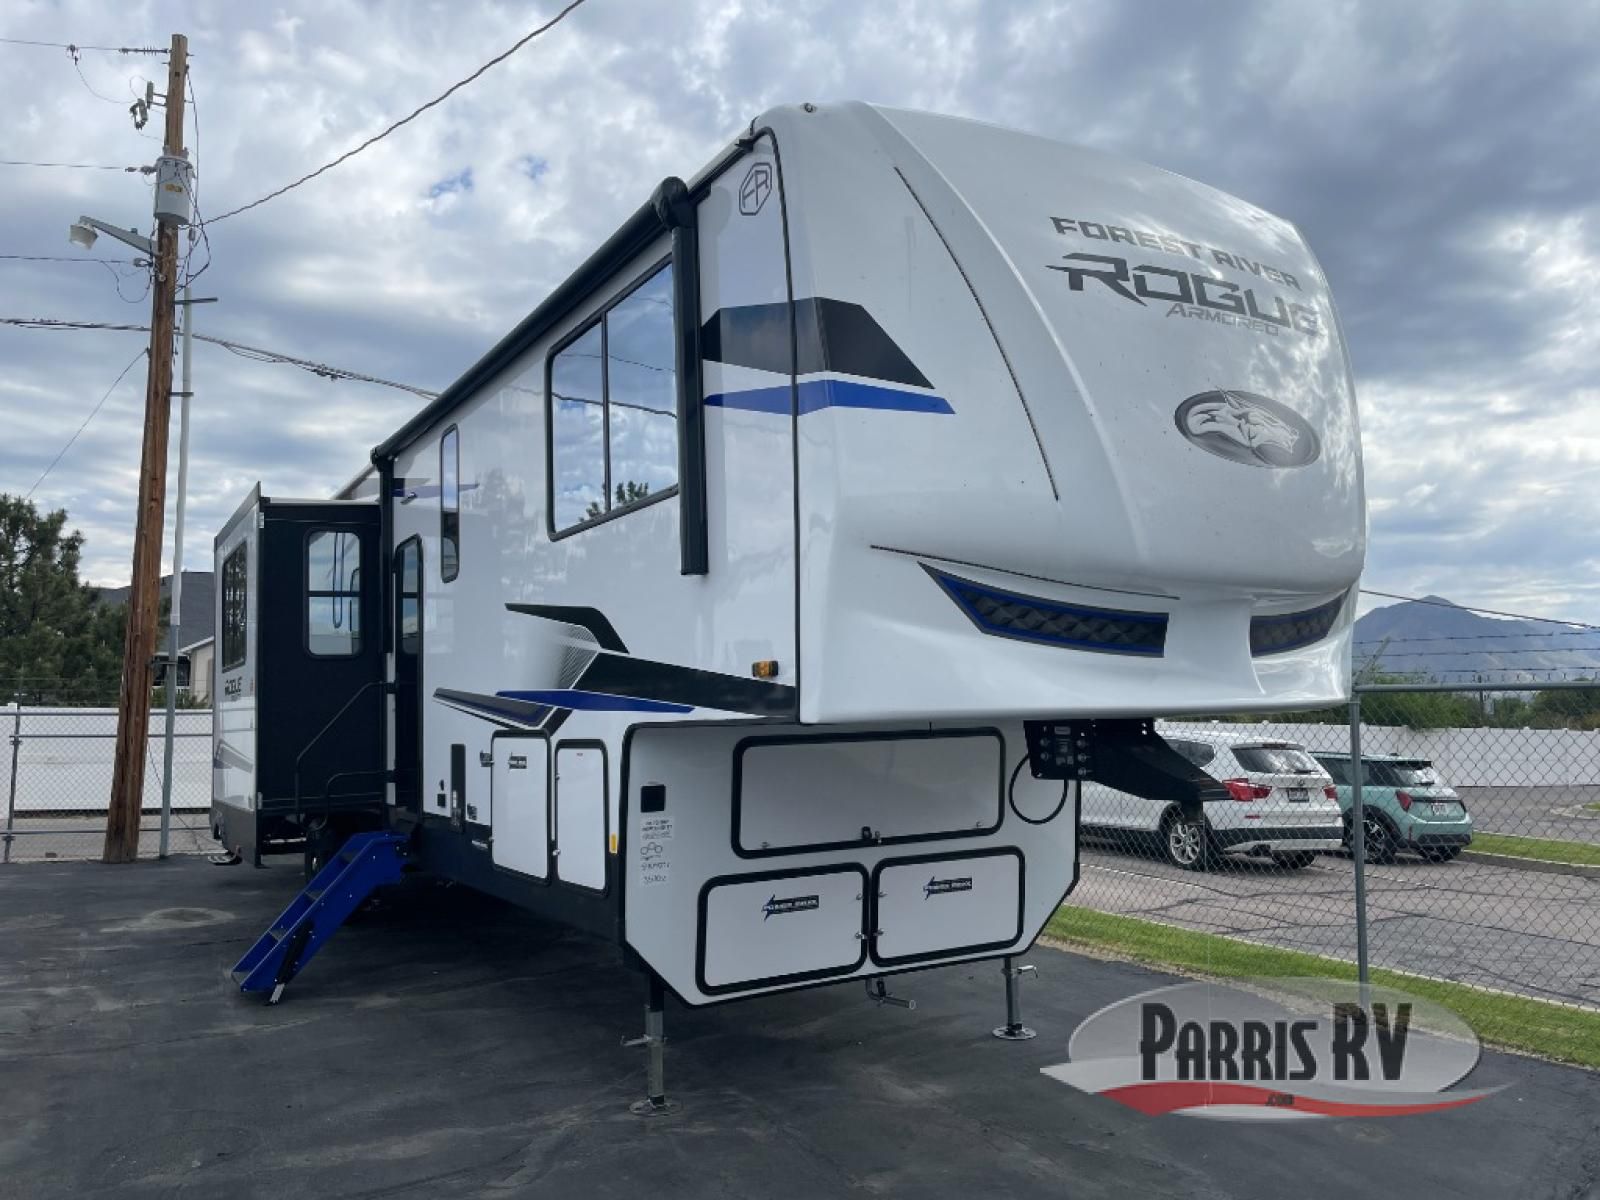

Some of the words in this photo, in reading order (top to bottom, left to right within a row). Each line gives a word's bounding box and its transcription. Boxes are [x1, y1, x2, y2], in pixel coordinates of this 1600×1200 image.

[1049, 216, 1201, 258] FOREST
[1208, 248, 1302, 291] RIVER
[1045, 252, 1322, 337] ROGUE
[1165, 302, 1279, 337] ARMORED
